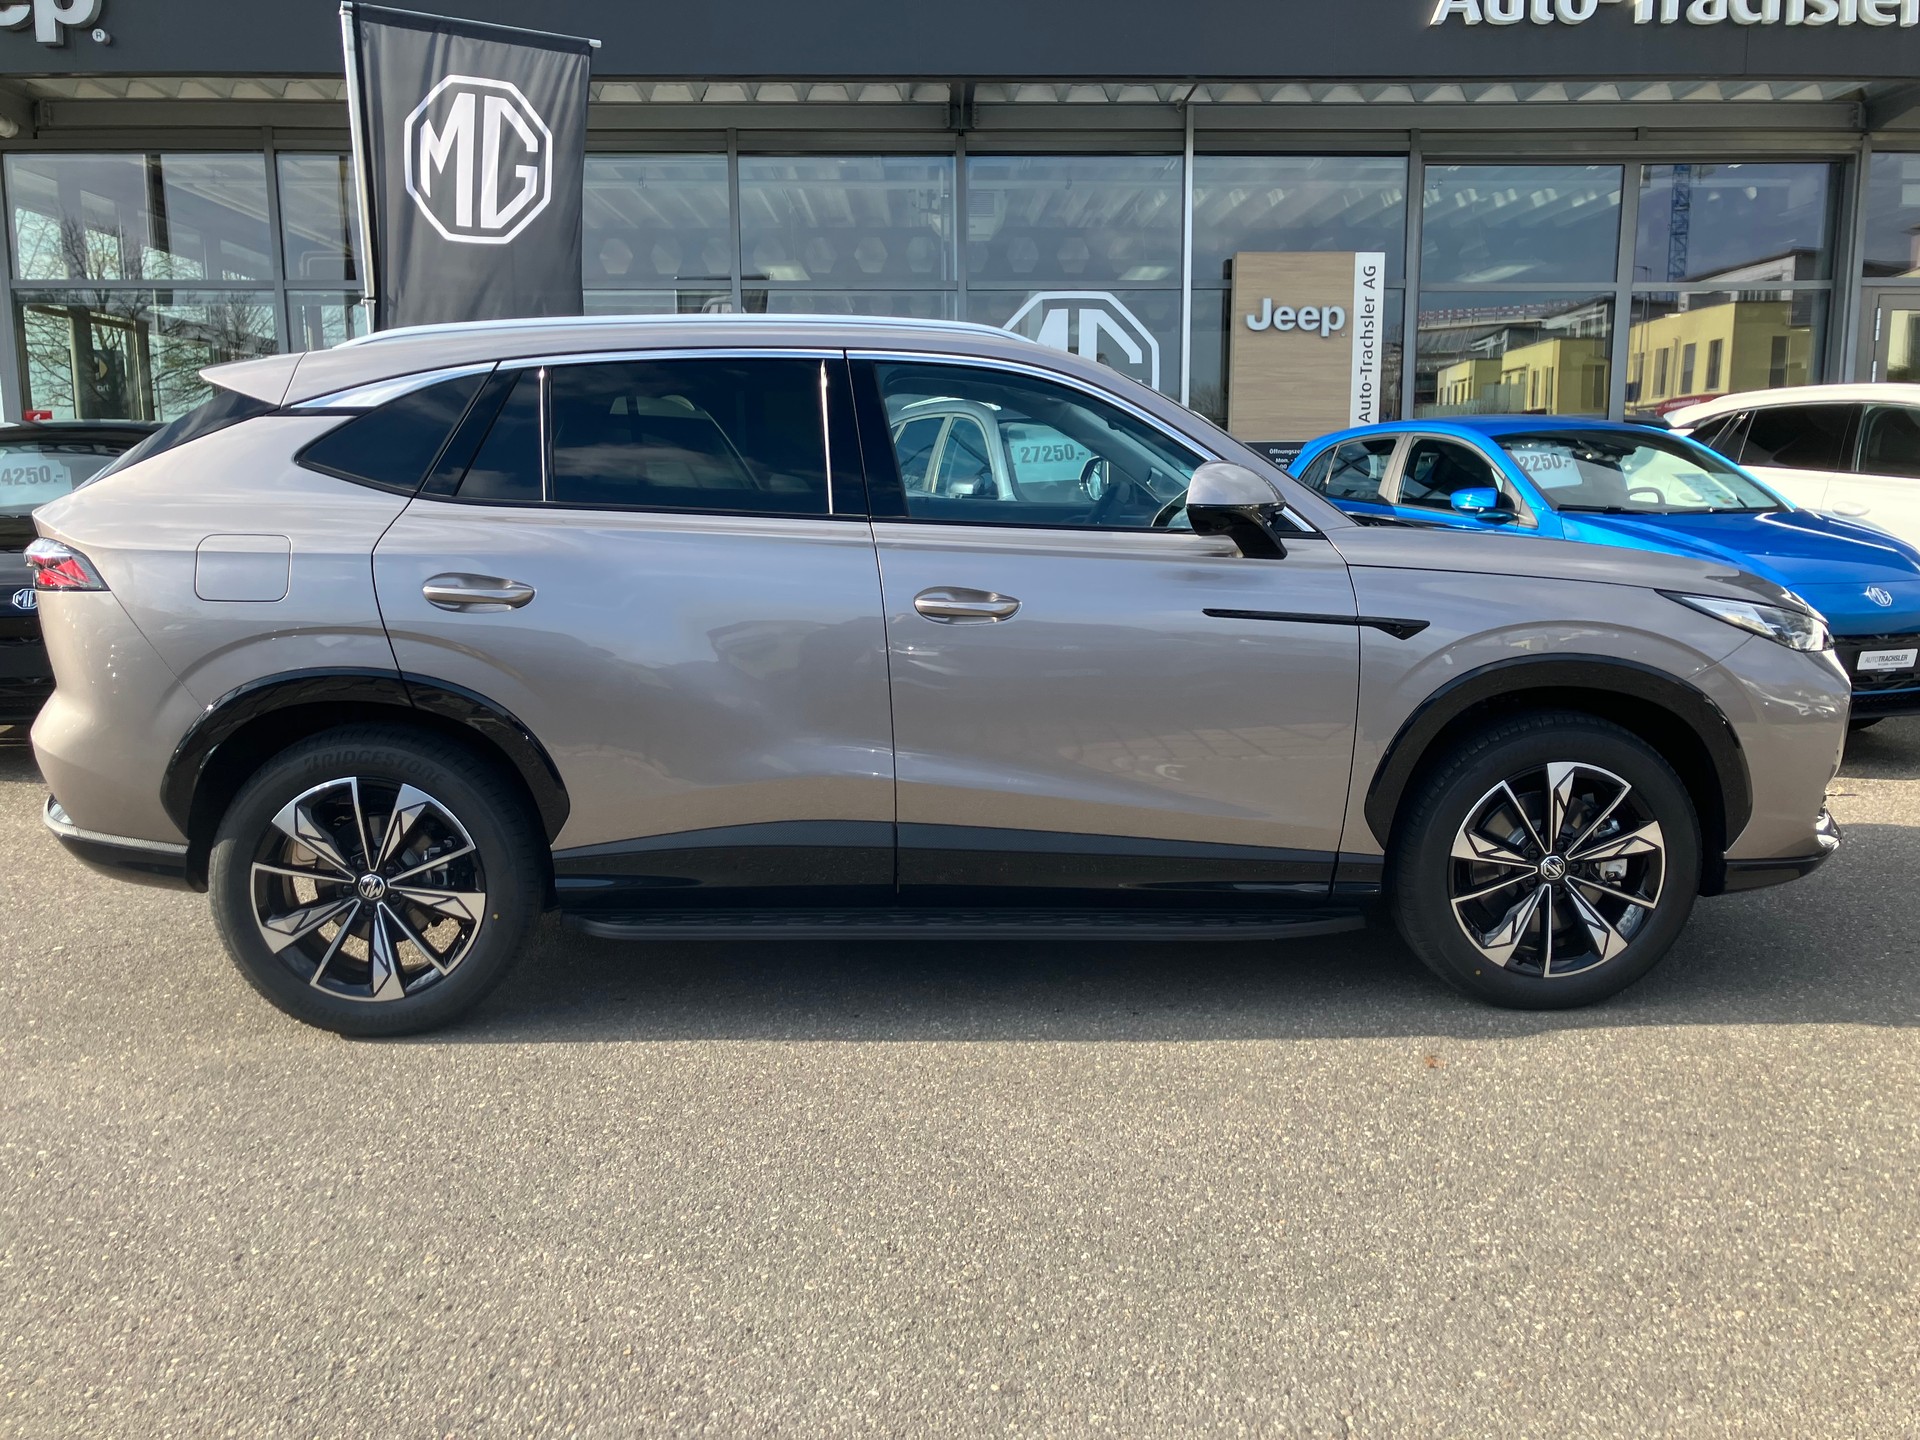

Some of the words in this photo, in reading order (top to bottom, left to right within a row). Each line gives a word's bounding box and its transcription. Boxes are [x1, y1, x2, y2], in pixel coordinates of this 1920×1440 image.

[419, 91, 540, 229] MG
[1246, 297, 1346, 337] Jeep
[1362, 265, 1377, 290] AG
[1358, 295, 1376, 424] Auto-Trachsler
